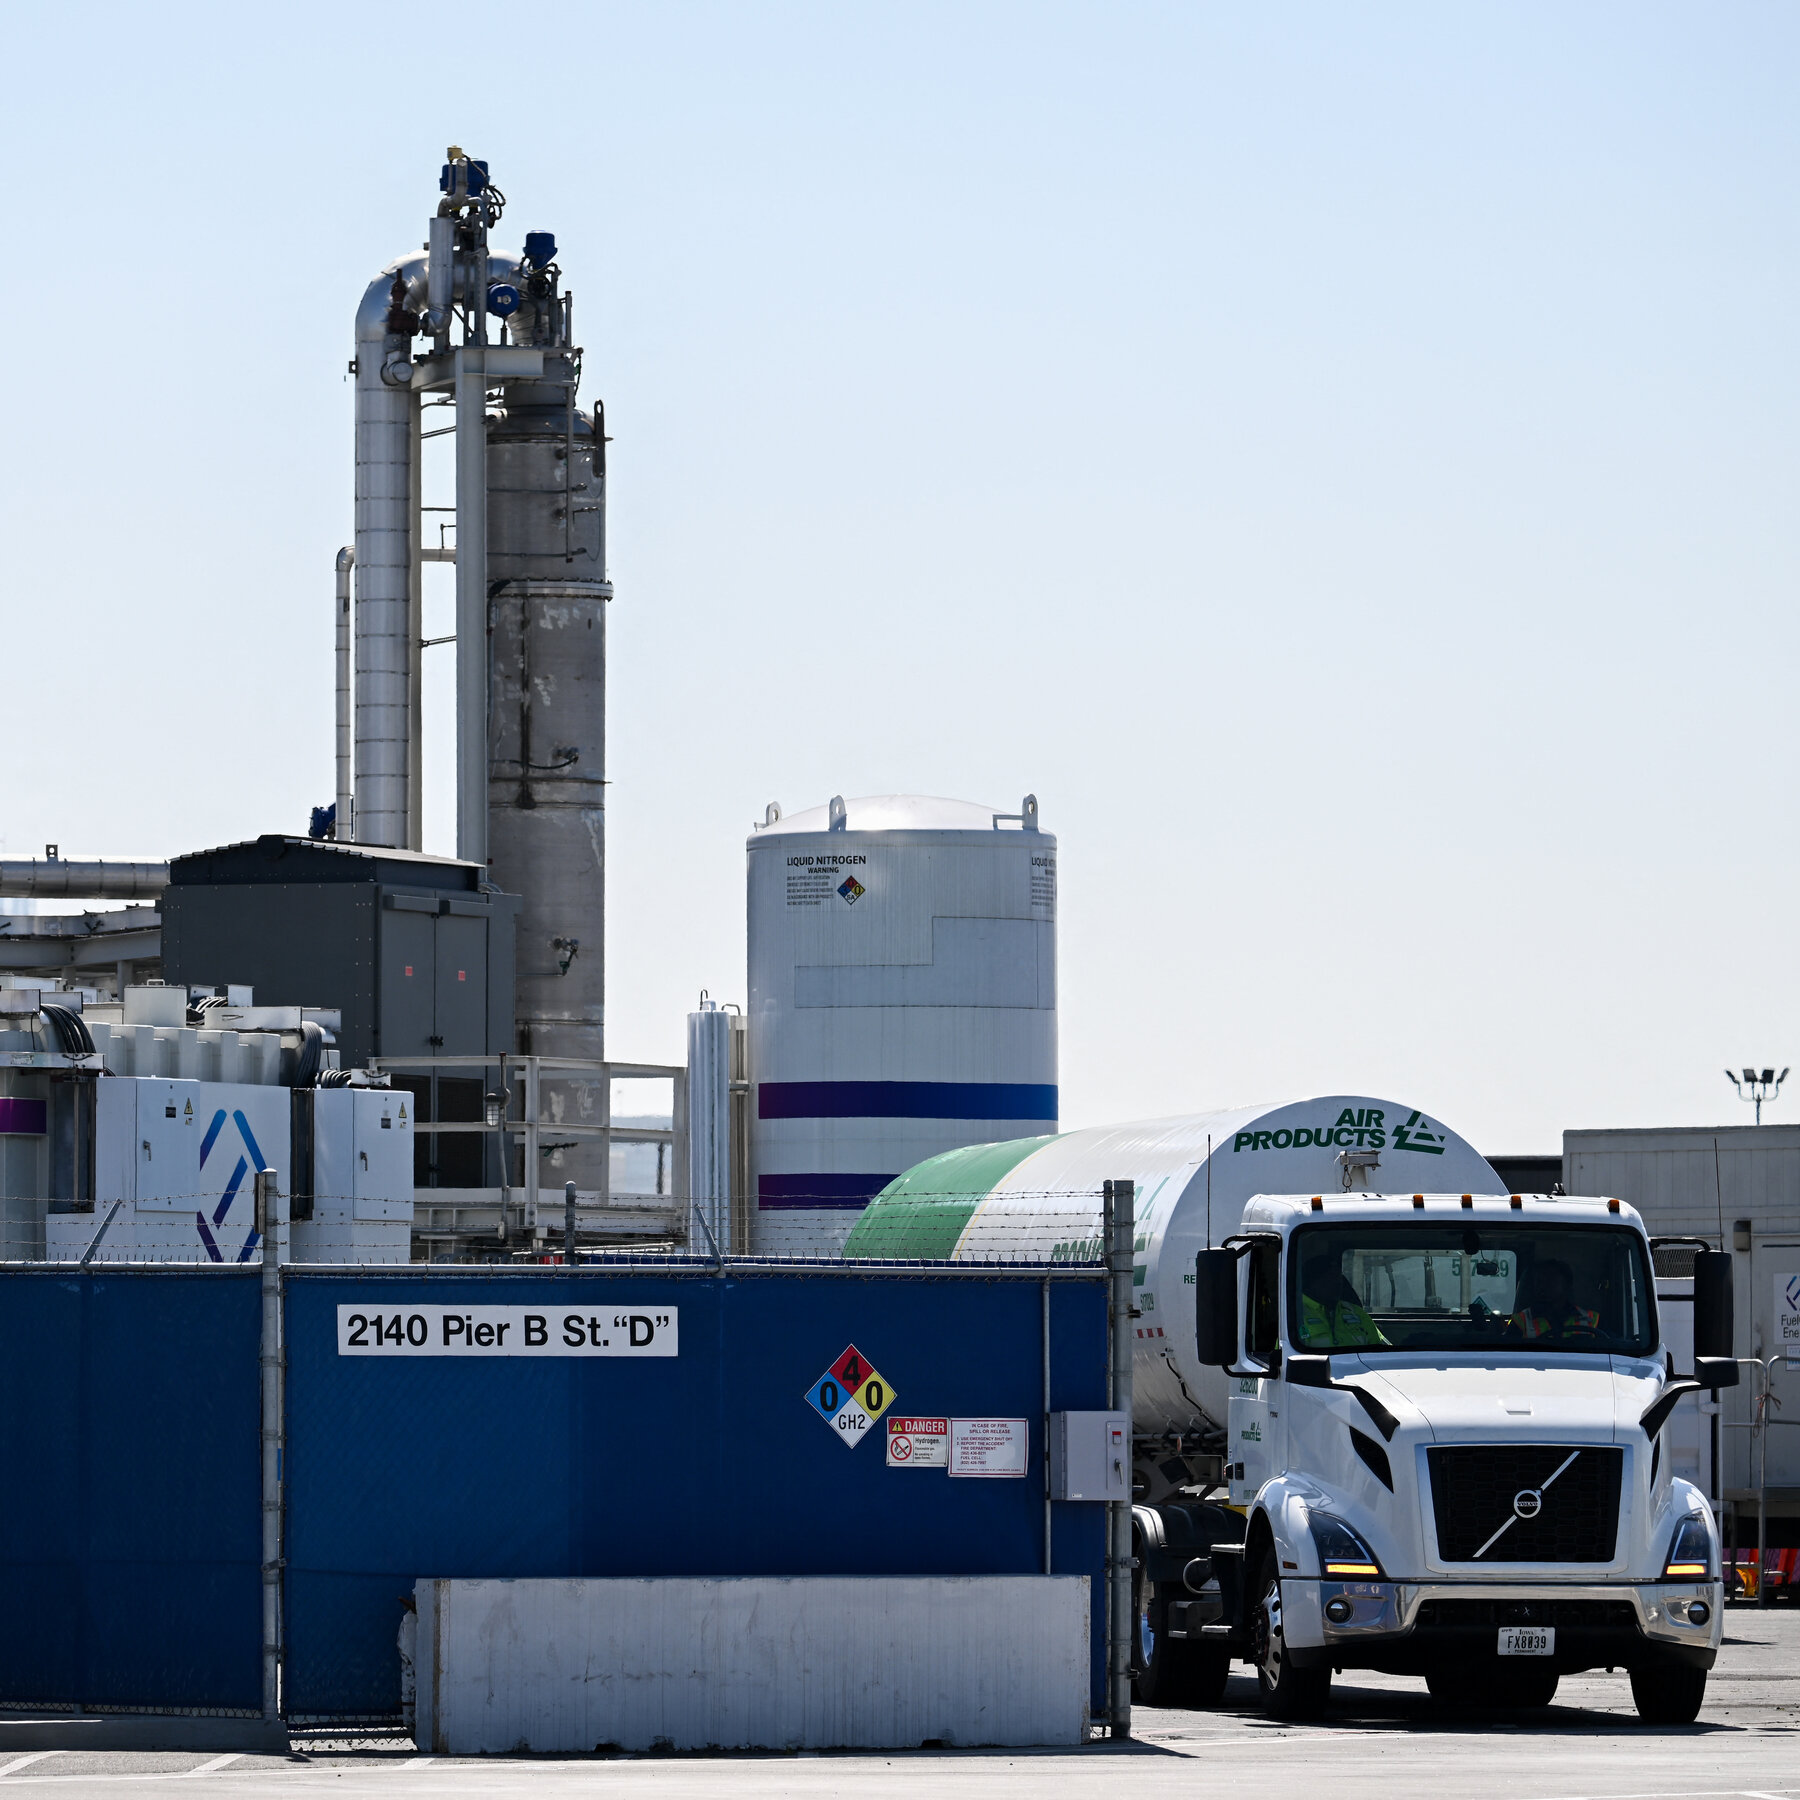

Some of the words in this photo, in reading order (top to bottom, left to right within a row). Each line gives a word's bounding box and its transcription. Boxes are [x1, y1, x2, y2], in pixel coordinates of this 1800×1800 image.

[787, 856, 815, 867] LIQUID
[816, 855, 866, 865] NITROGEN
[854, 885, 861, 895] 0
[1335, 1108, 1385, 1128] AIR
[1233, 1127, 1386, 1153] PRODUCTS
[347, 1314, 428, 1346] 2140
[442, 1314, 510, 1347] Pier
[524, 1315, 548, 1346] B
[842, 1355, 860, 1386] 4
[819, 1381, 838, 1412] 0
[865, 1381, 883, 1411] 0
[838, 1414, 866, 1431] GH2
[905, 1421, 944, 1432] DANGER
[915, 1437, 940, 1445] Hydrogen.
[1507, 1635, 1547, 1649] FX8039
